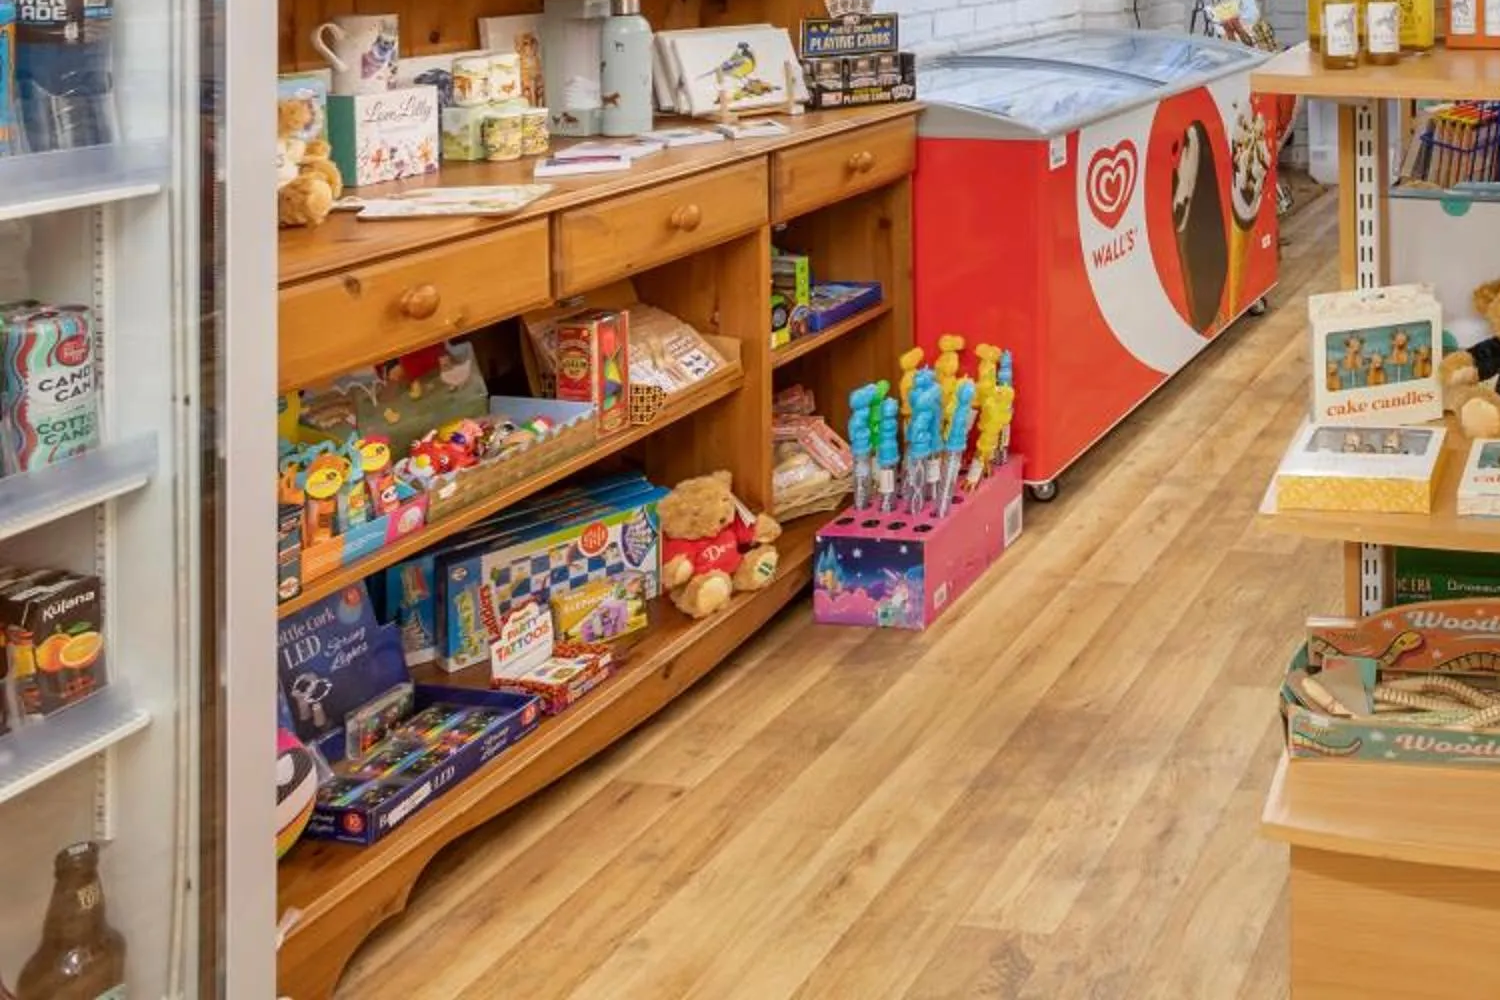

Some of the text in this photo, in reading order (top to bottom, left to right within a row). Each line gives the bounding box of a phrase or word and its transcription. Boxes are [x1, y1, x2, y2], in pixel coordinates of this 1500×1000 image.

[21, 6, 68, 22] ADE
[1092, 231, 1136, 269] WALL'S
[37, 367, 91, 392] CAND
[1326, 389, 1435, 417] cake candles
[36, 409, 95, 436] COTT
[283, 634, 321, 670] LED
